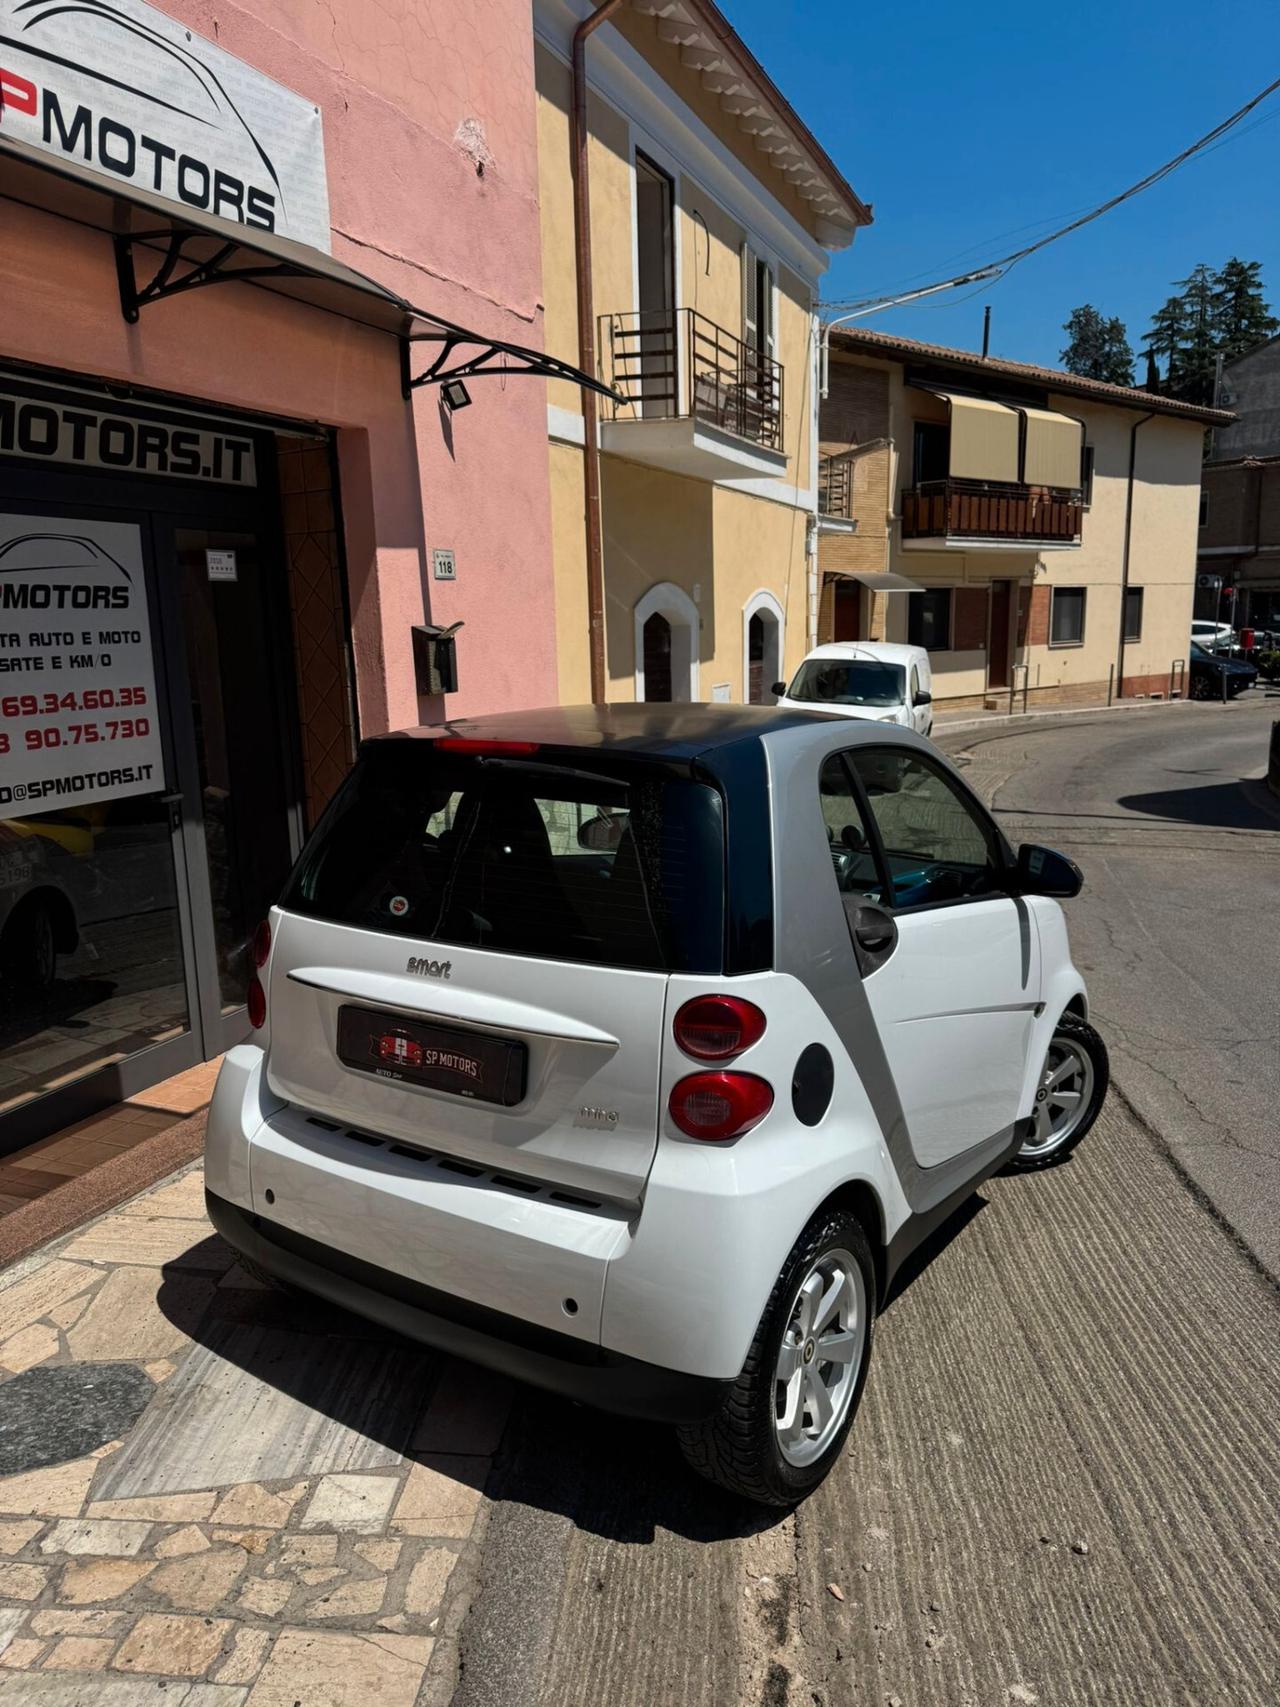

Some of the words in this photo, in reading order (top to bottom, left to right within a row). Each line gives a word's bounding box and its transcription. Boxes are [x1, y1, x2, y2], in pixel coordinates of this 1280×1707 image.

[438, 561, 452, 573] 118
[0, 584, 129, 609] MOTORS
[29, 632, 74, 647] AUTO
[82, 631, 92, 645] E
[99, 631, 141, 644] MOTO
[52, 656, 62, 669] E
[2, 686, 147, 718] 69.34.60.35
[25, 718, 150, 750] 90.75.730
[407, 957, 451, 979] smart
[426, 1050, 438, 1064] SP
[439, 1052, 478, 1077] MOTORS
